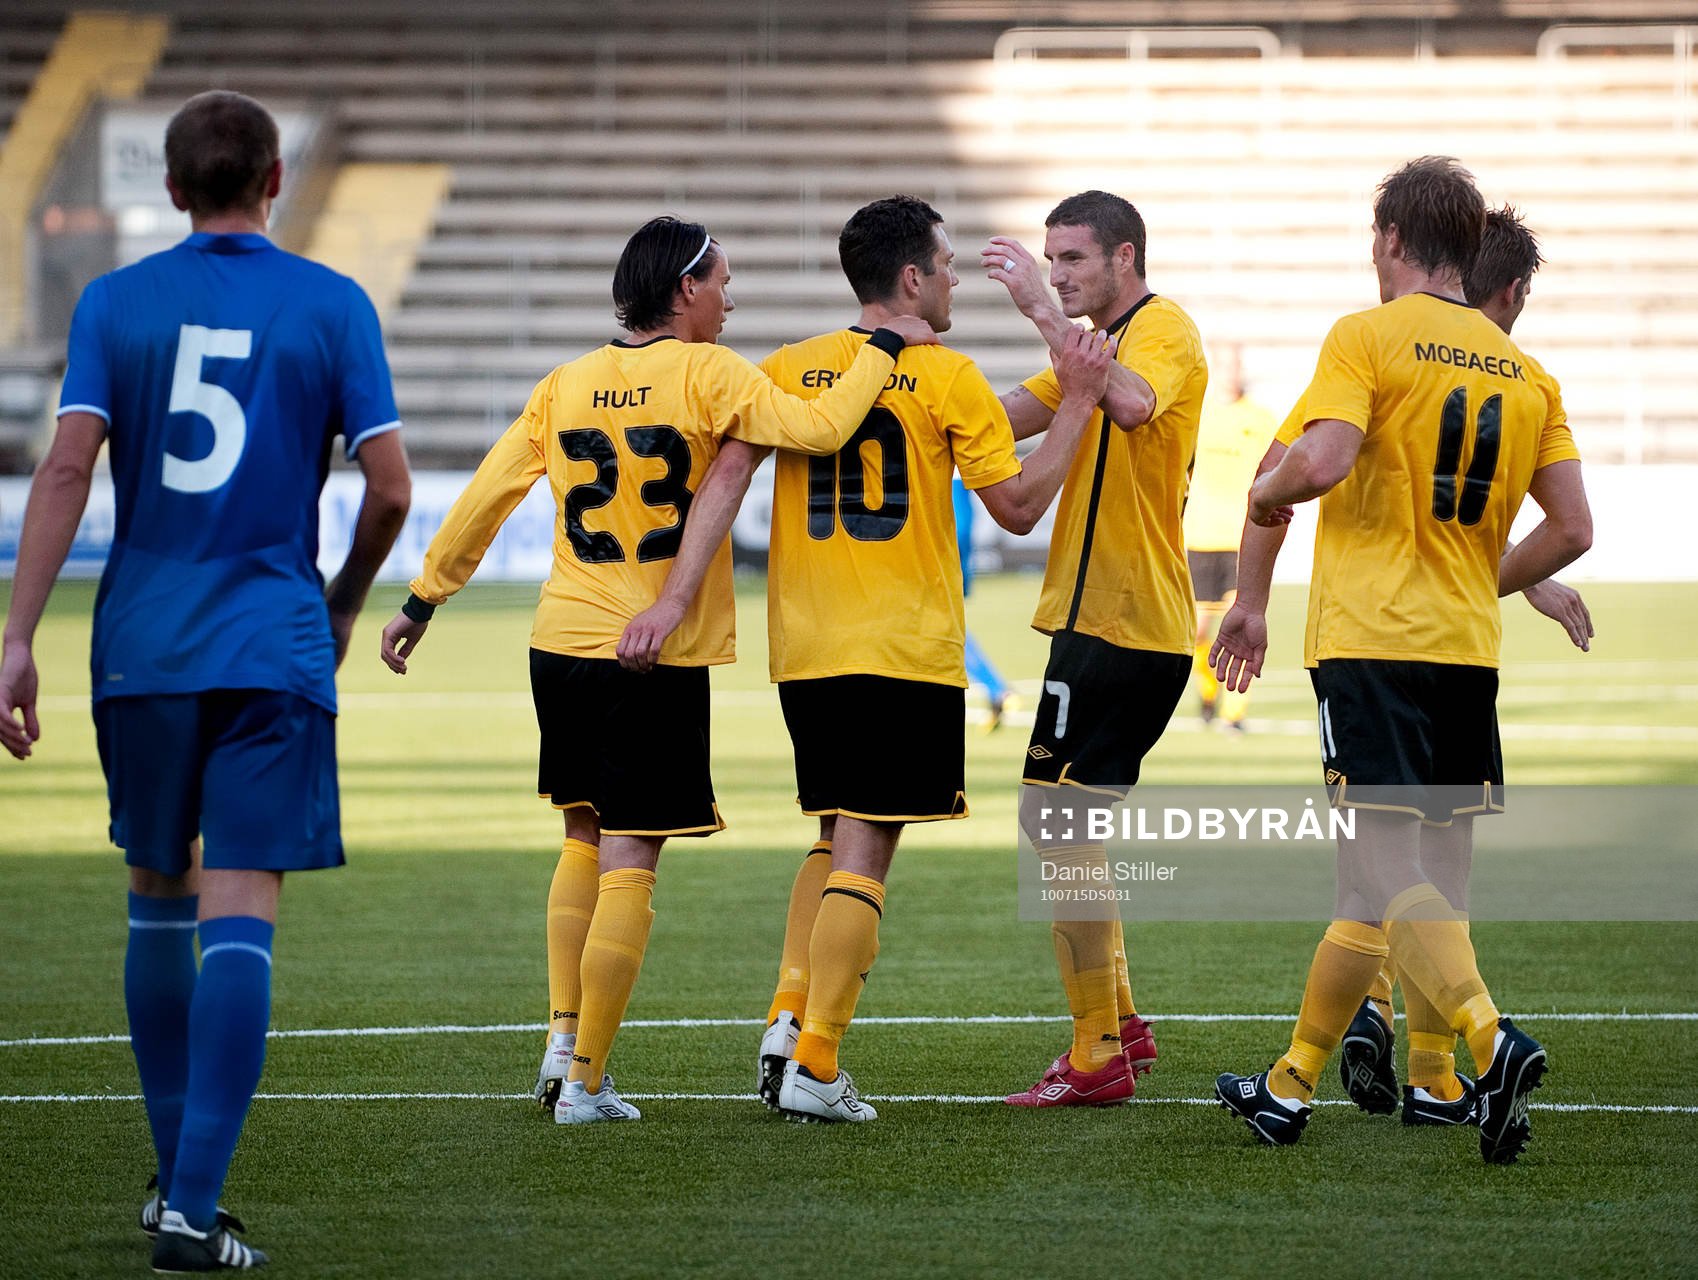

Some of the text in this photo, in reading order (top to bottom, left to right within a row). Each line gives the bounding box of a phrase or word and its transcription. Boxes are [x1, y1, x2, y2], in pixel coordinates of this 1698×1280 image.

[161, 323, 253, 494] 5
[592, 386, 652, 408] HULT
[801, 369, 917, 393] ERON
[1414, 342, 1526, 382] MOBAECK
[557, 424, 695, 563] 23
[807, 407, 909, 541] 10
[1432, 385, 1503, 526] 11
[1045, 680, 1071, 739] 7
